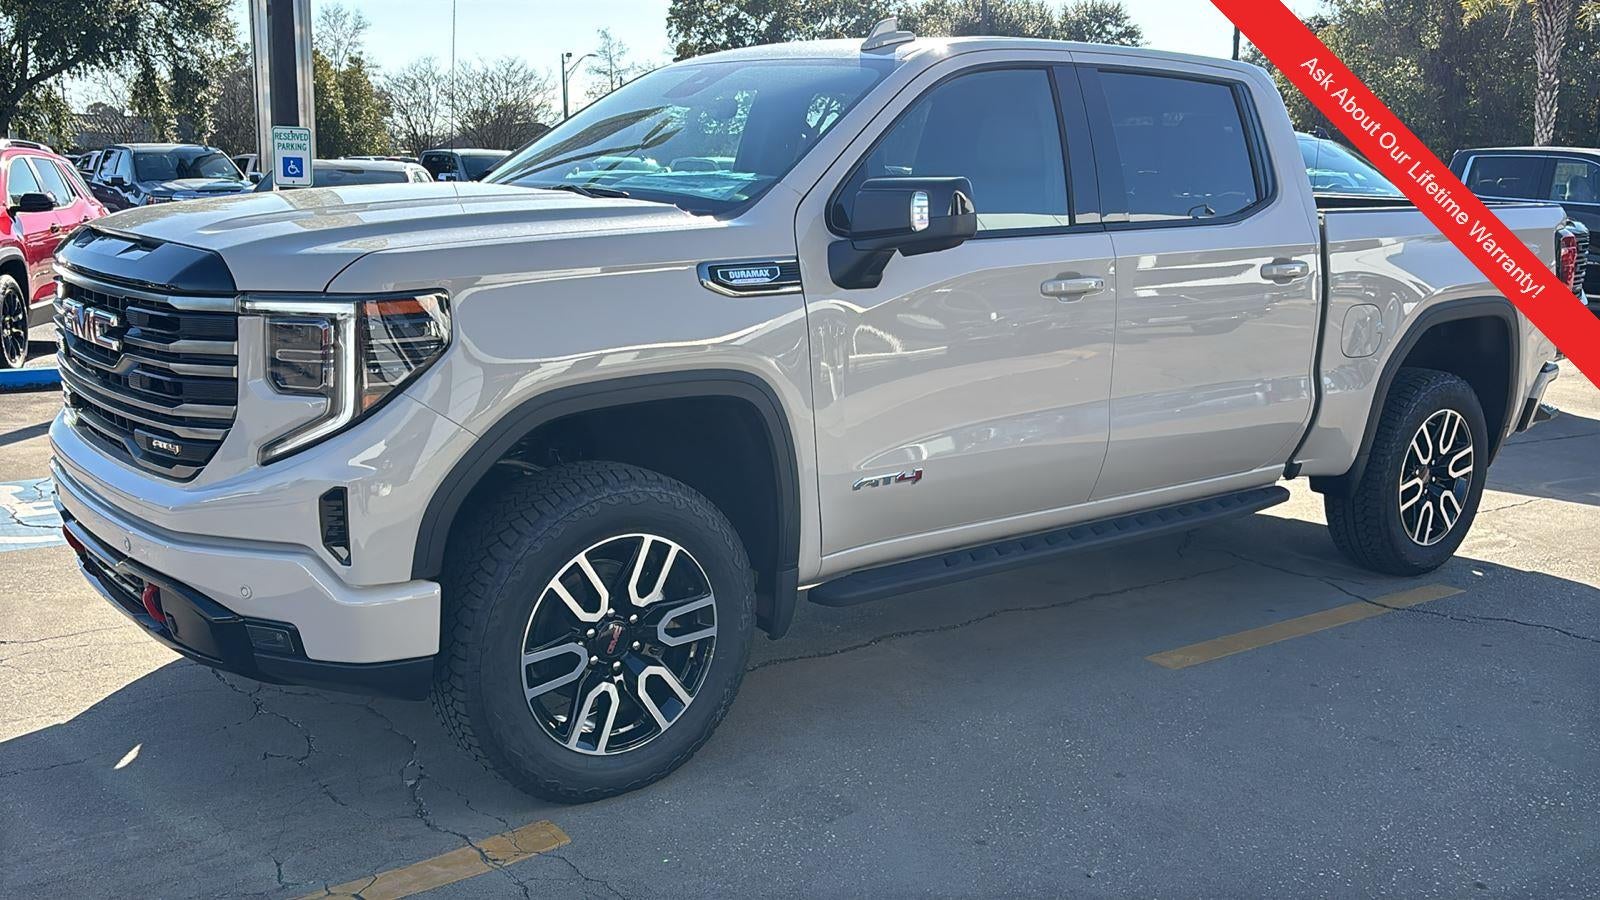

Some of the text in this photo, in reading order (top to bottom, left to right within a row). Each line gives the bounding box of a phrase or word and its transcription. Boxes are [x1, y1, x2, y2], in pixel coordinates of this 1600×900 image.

[275, 132, 309, 141] RESERVED
[277, 143, 307, 151] PARKING
[728, 269, 770, 279] DURAMAX
[62, 298, 119, 352] GMC
[852, 468, 923, 491] AT4
